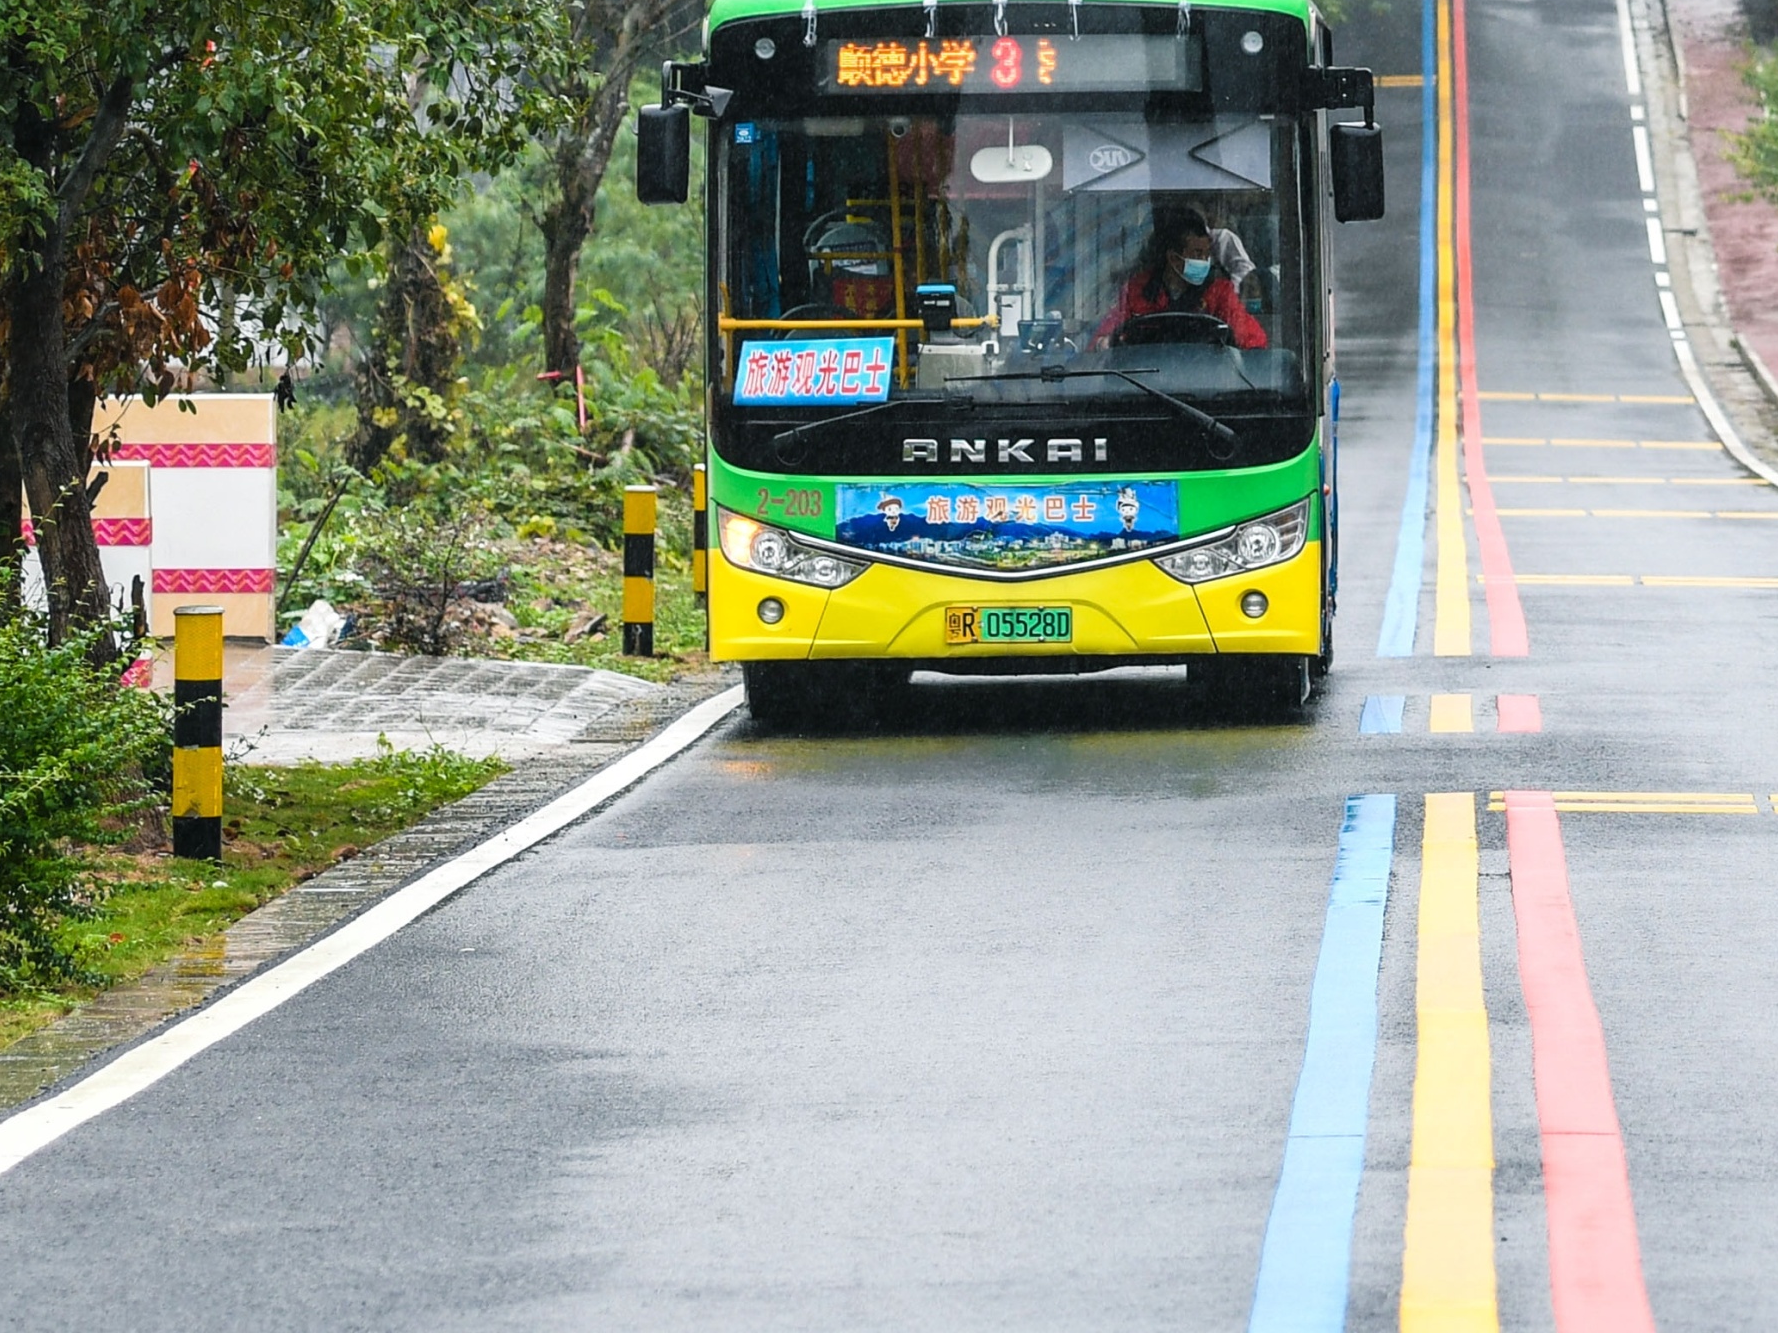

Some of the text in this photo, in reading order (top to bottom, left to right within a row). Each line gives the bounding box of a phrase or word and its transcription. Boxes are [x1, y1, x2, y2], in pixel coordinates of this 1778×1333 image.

[991, 36, 1022, 89] 3
[743, 348, 886, 396] 旅游观光巴士
[902, 438, 1107, 463] ANKAI
[757, 488, 822, 517] 2-203
[926, 494, 1096, 524] 旅游观光巴士
